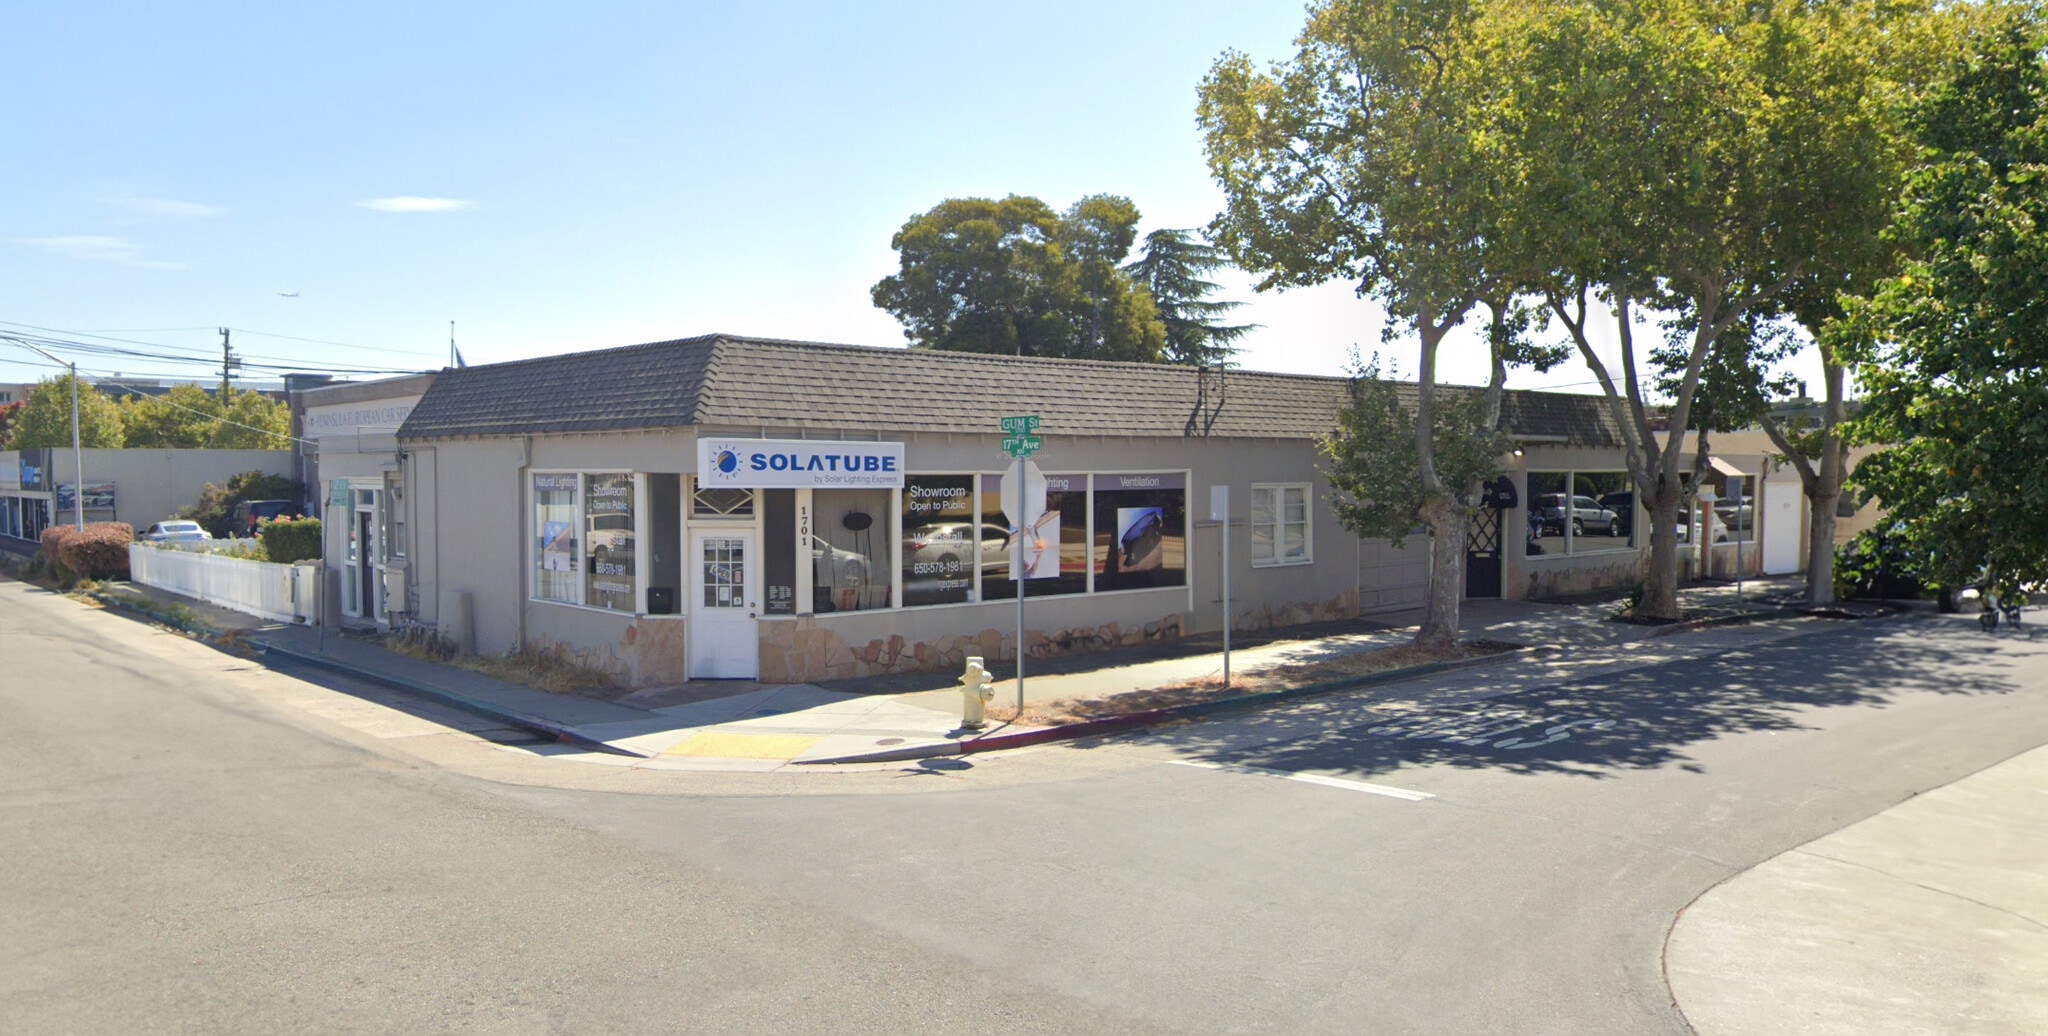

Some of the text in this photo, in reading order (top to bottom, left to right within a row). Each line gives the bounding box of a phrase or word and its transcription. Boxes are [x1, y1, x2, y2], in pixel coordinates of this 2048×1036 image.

[382, 406, 395, 424] CAR
[1002, 417, 1038, 430] GUM St
[1003, 439, 1040, 450] 17TH Ave
[750, 453, 896, 472] SOLATUBE
[535, 475, 577, 490] Natural Lighting
[814, 475, 897, 485] by Solar Lighting Express
[1120, 476, 1160, 487] Ventilation
[593, 483, 628, 496] Showroom
[910, 485, 966, 498] Showroom
[592, 500, 606, 511] Open
[612, 500, 628, 510] Public
[910, 500, 966, 512] Open to Public
[711, 565, 730, 581] OPEN
[914, 560, 962, 575] 650-578-1981
